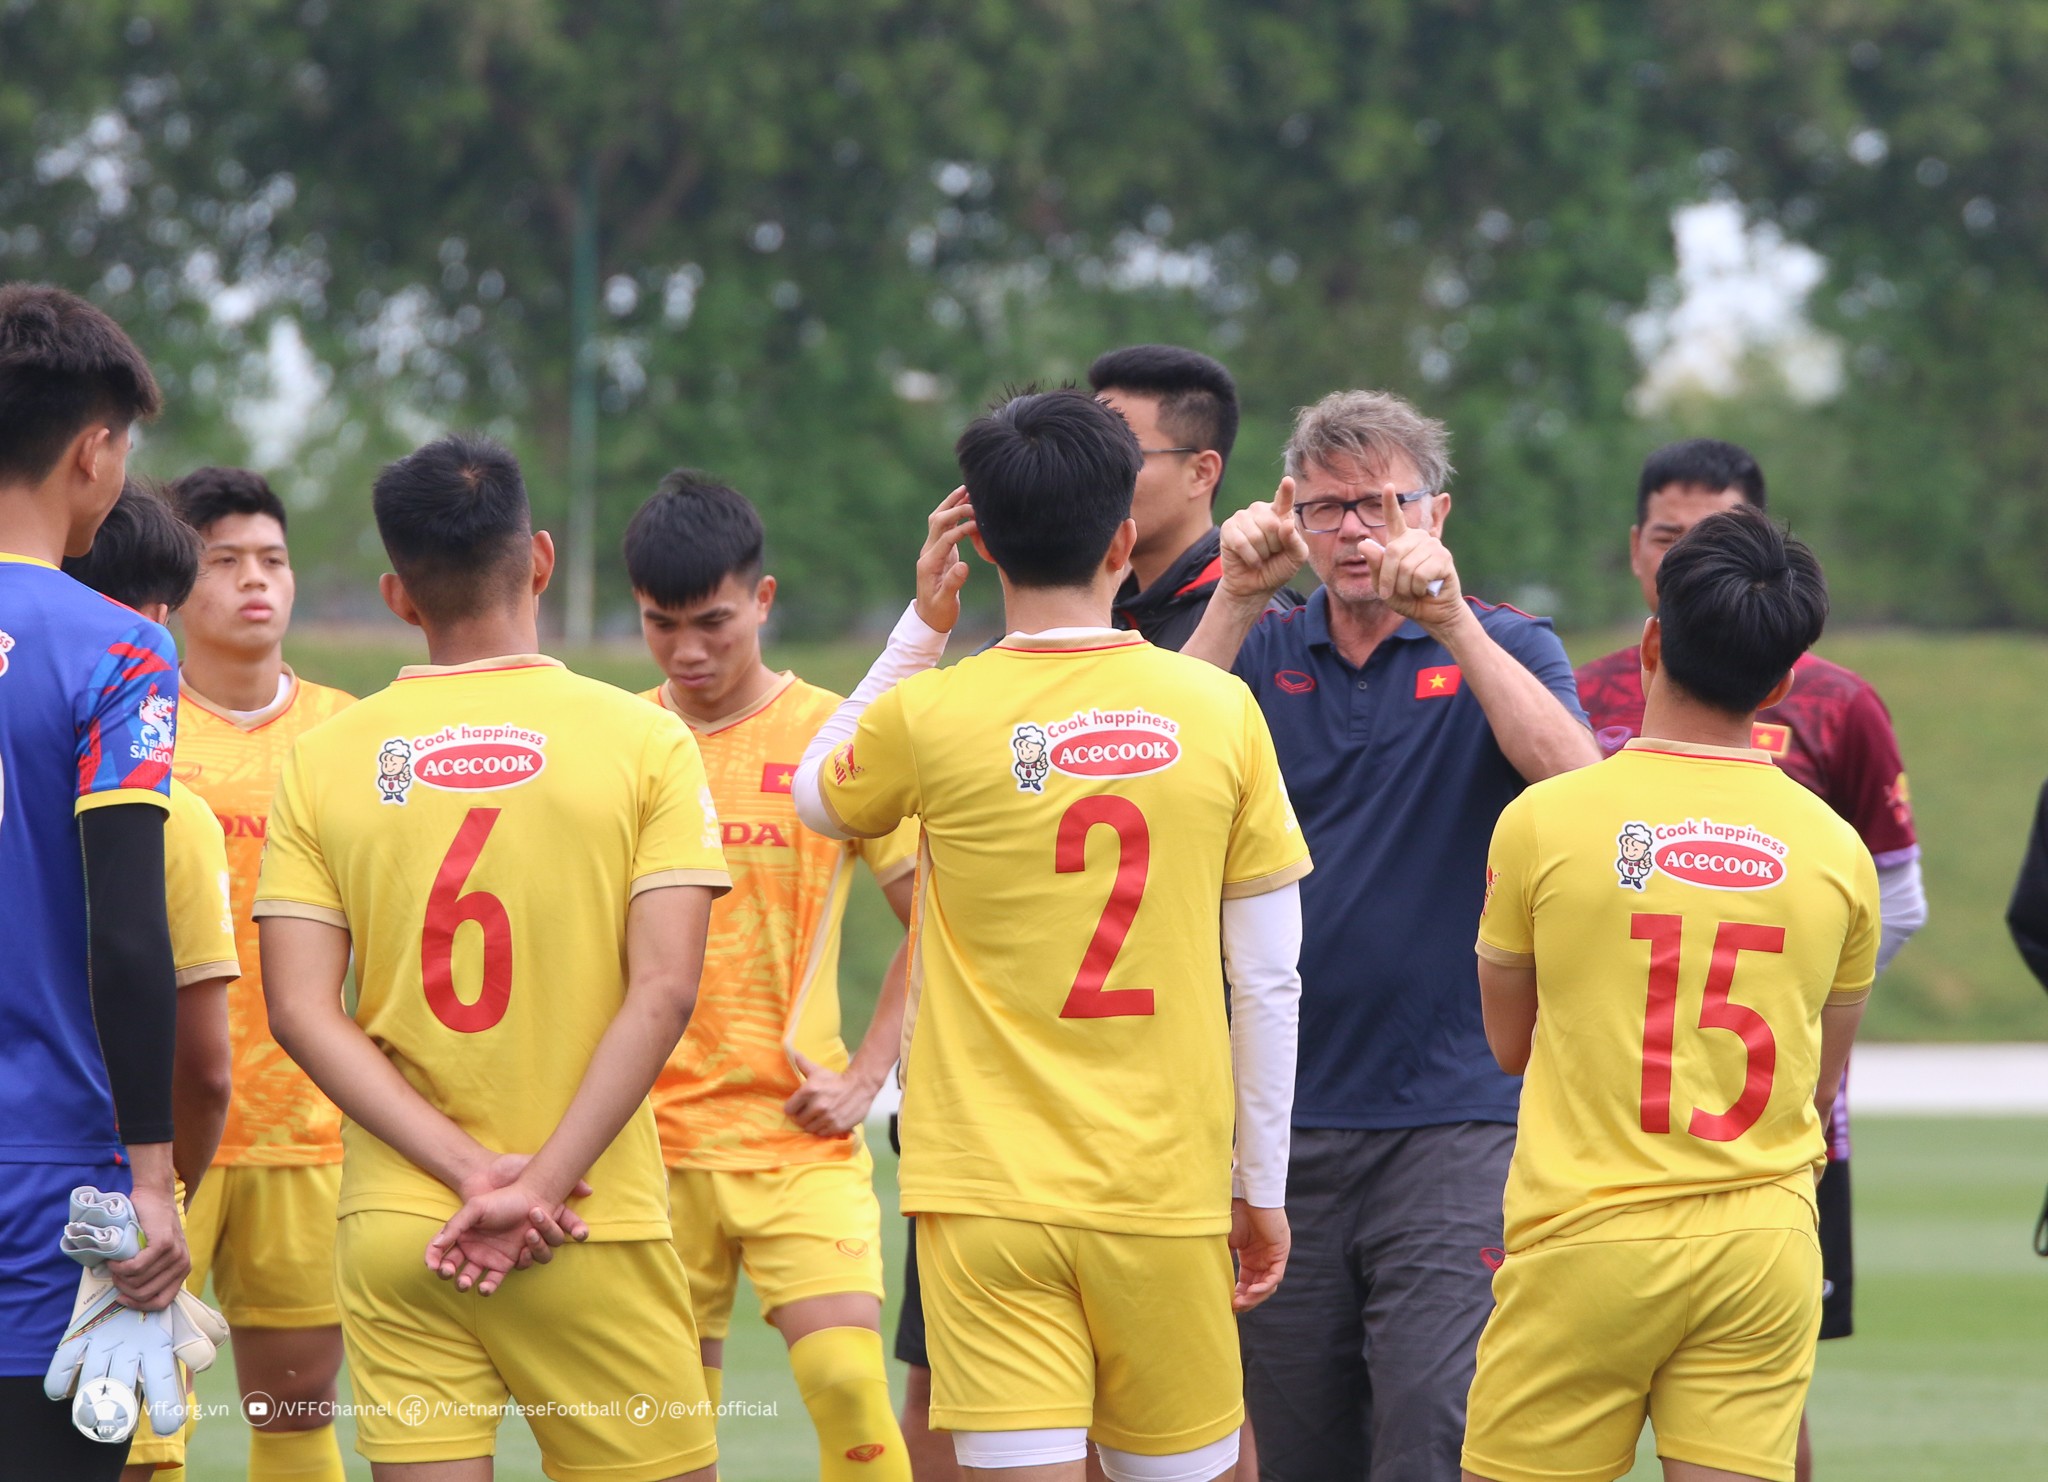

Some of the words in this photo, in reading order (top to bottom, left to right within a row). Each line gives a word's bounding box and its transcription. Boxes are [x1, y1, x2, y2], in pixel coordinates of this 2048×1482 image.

[413, 728, 457, 752] Cook
[461, 725, 545, 746] happiness
[1047, 714, 1089, 738] Cook
[1093, 709, 1177, 733] happiness
[1655, 820, 1698, 840] Cook
[1703, 821, 1786, 855] happiness
[421, 807, 513, 1034] 6
[1055, 794, 1155, 1018] 2
[1630, 912, 1786, 1142] 15
